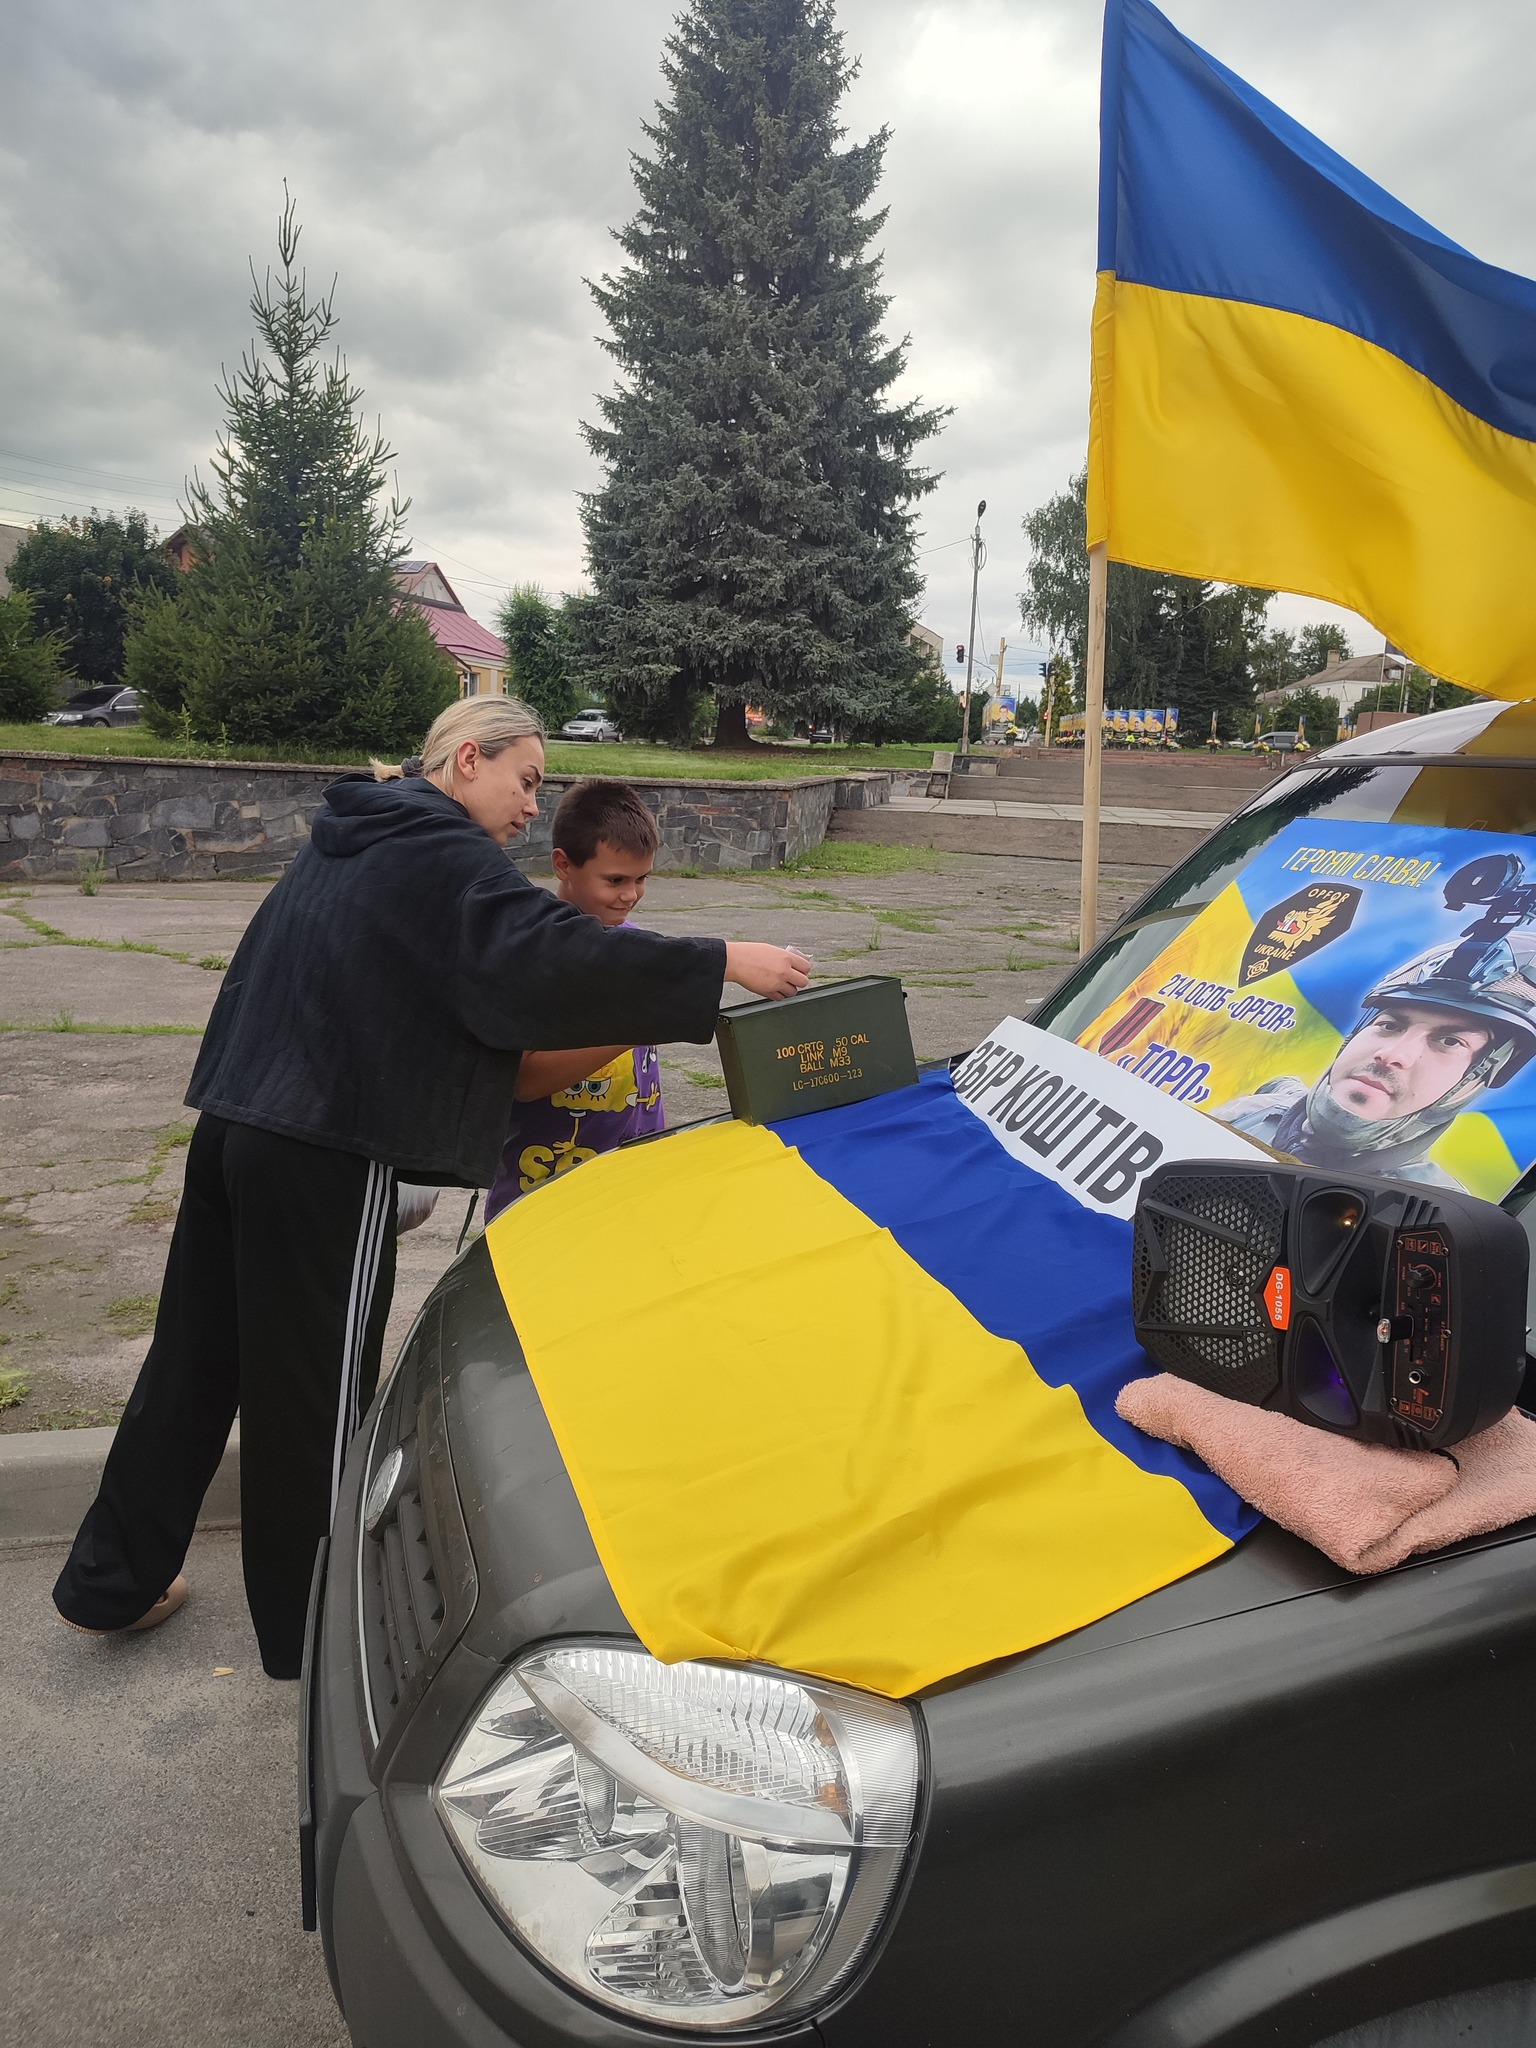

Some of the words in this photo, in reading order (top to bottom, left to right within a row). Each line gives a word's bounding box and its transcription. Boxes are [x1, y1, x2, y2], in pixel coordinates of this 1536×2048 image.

[1280, 847, 1364, 878] ГЕРОЯМ
[1352, 854, 1443, 889] СЛАВА!
[1307, 888, 1351, 903] OPFOR
[1254, 943, 1296, 961] UKRAINE
[1158, 973, 1195, 999] 214
[1184, 981, 1235, 1012] ОСПБ
[1227, 995, 1296, 1033] «OPFOR»
[775, 1045, 796, 1060] 100
[797, 1041, 824, 1054] CRTG
[850, 1033, 870, 1045] CAL
[800, 1051, 825, 1064] LINK
[832, 1047, 848, 1058] M9
[800, 1061, 825, 1074] BALL
[829, 1056, 852, 1068] M33
[953, 1040, 1025, 1104] ЗБІР
[987, 1064, 1164, 1204] КОШТІВ
[1274, 1273, 1284, 1321] DG-1055
